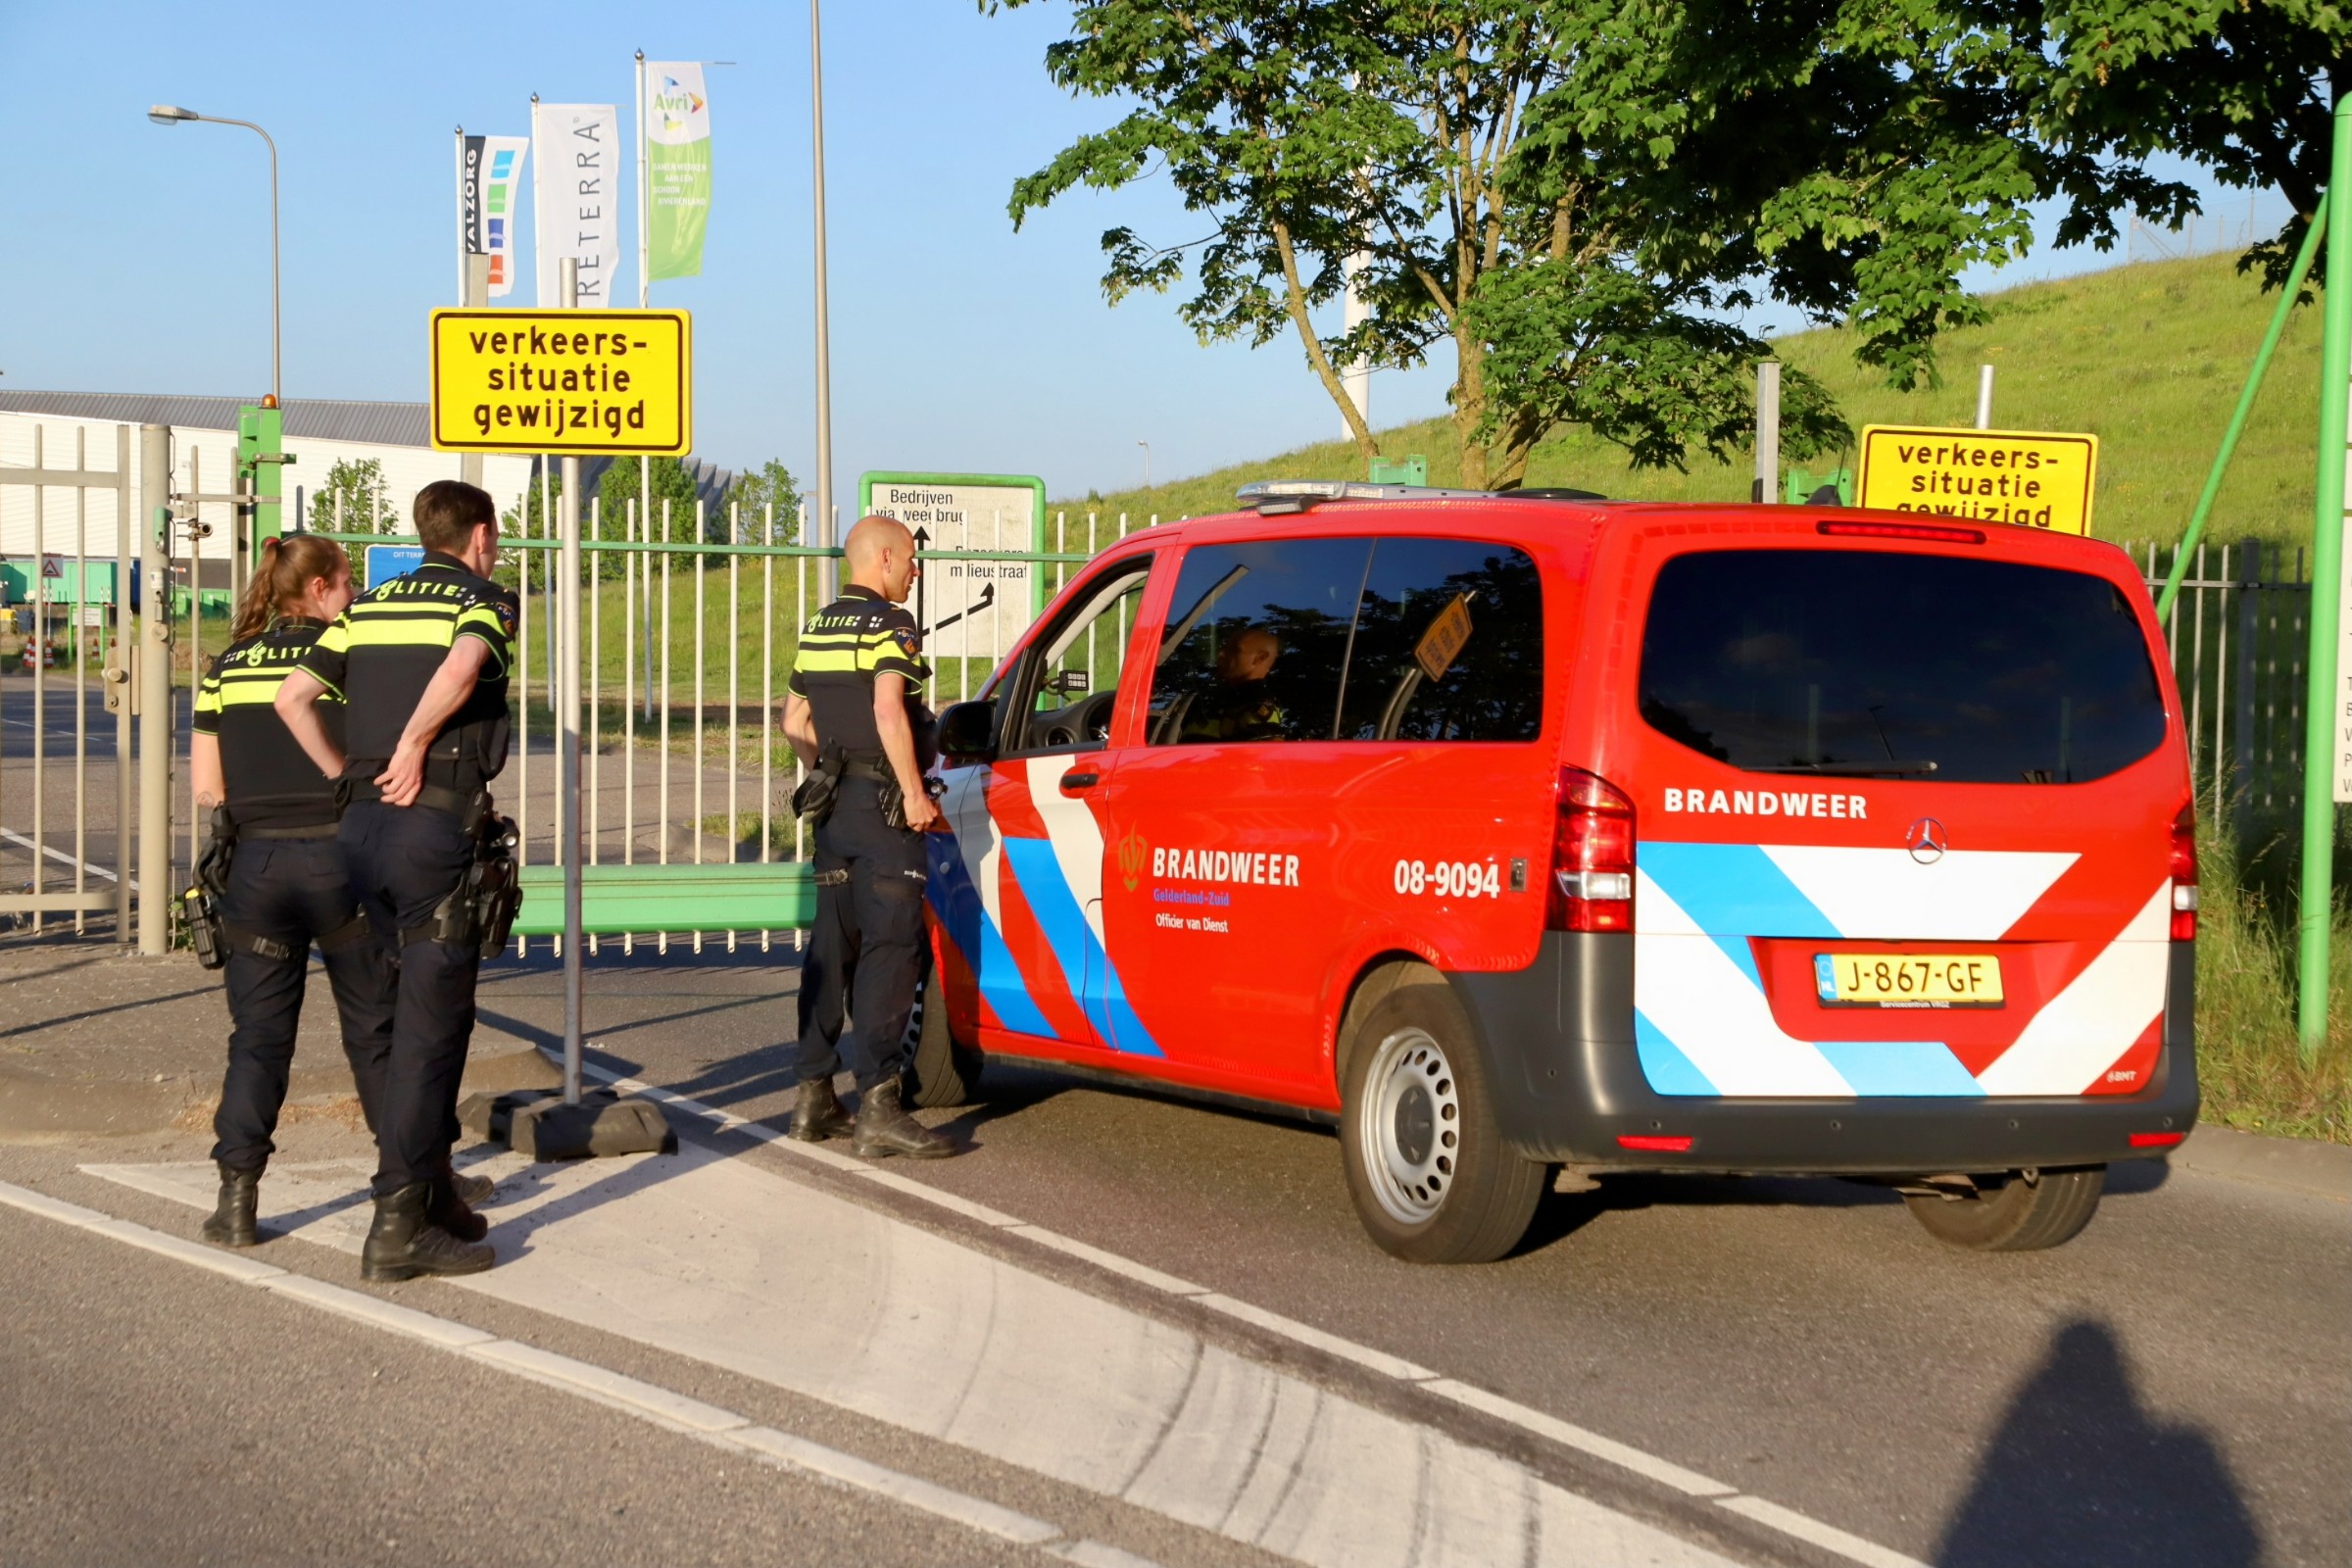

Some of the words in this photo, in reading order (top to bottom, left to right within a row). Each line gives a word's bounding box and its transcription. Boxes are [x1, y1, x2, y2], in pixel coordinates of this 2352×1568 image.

[654, 93, 688, 110] Avri
[573, 122, 600, 297] RETERRA
[469, 324, 647, 356] verkeers-
[488, 362, 631, 392] situatie
[473, 398, 644, 438] gewijzigd
[1898, 442, 2058, 469] verkeers-
[890, 489, 953, 508] Bedrijven
[1911, 470, 2040, 498] situatie
[951, 564, 1027, 578] mlieustraa
[1664, 788, 1867, 819] BRANDWEER
[1152, 847, 1299, 887] BRANDWEER
[1395, 859, 1500, 899] 08-9094
[1153, 888, 1230, 906] Gelderland-Zuid
[1155, 912, 1184, 929] Officier
[1186, 918, 1201, 931] van
[1202, 917, 1229, 933] Dienst
[1821, 981, 1836, 992] NL
[1848, 961, 1982, 993] J-867-GF
